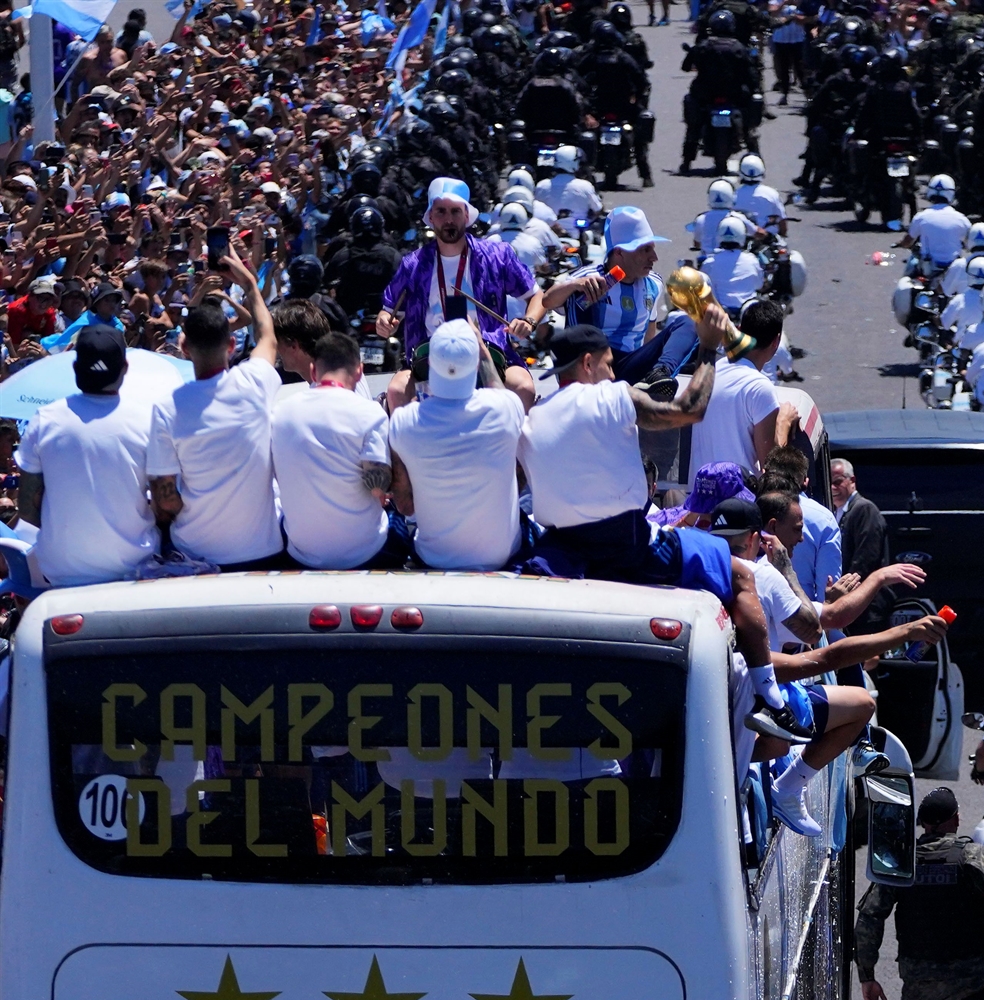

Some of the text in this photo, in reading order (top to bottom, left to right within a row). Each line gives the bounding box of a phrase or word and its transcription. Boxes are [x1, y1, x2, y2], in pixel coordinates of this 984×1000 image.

[102, 682, 633, 762] CAMPEONES
[126, 777, 631, 858] DEL MUNDO
